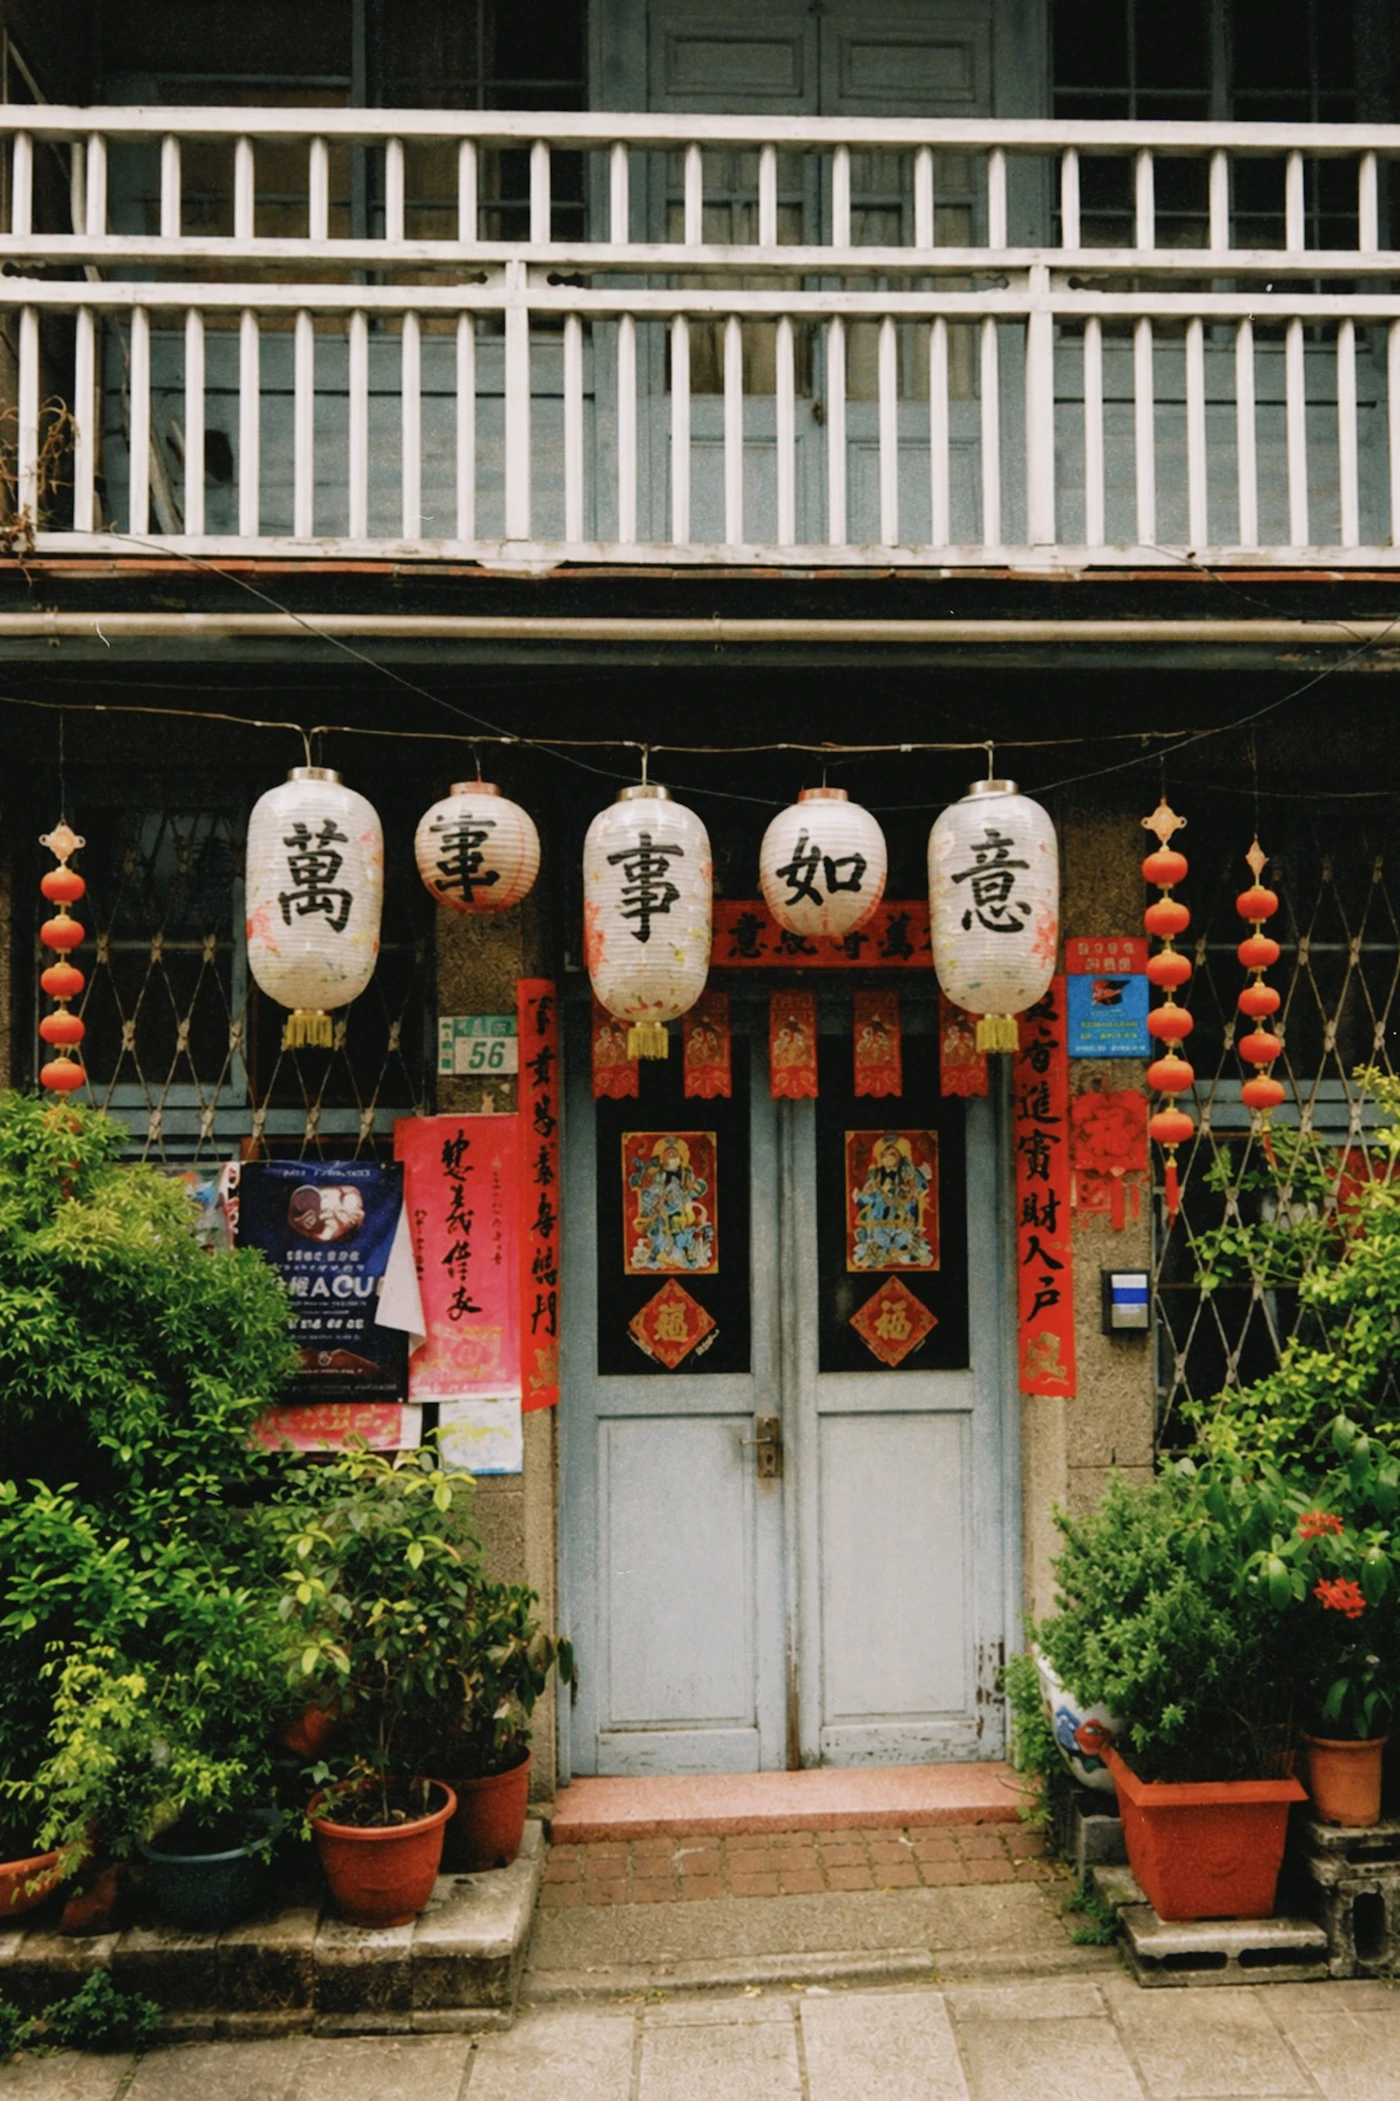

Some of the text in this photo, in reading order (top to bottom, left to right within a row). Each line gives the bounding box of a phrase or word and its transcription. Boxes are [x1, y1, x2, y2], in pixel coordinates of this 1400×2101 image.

[277, 818, 354, 933] 萬
[607, 831, 684, 943] 事
[776, 828, 867, 907] 如
[951, 829, 1031, 933] 意
[468, 1041, 506, 1069] 56
[874, 1301, 912, 1340] 福
